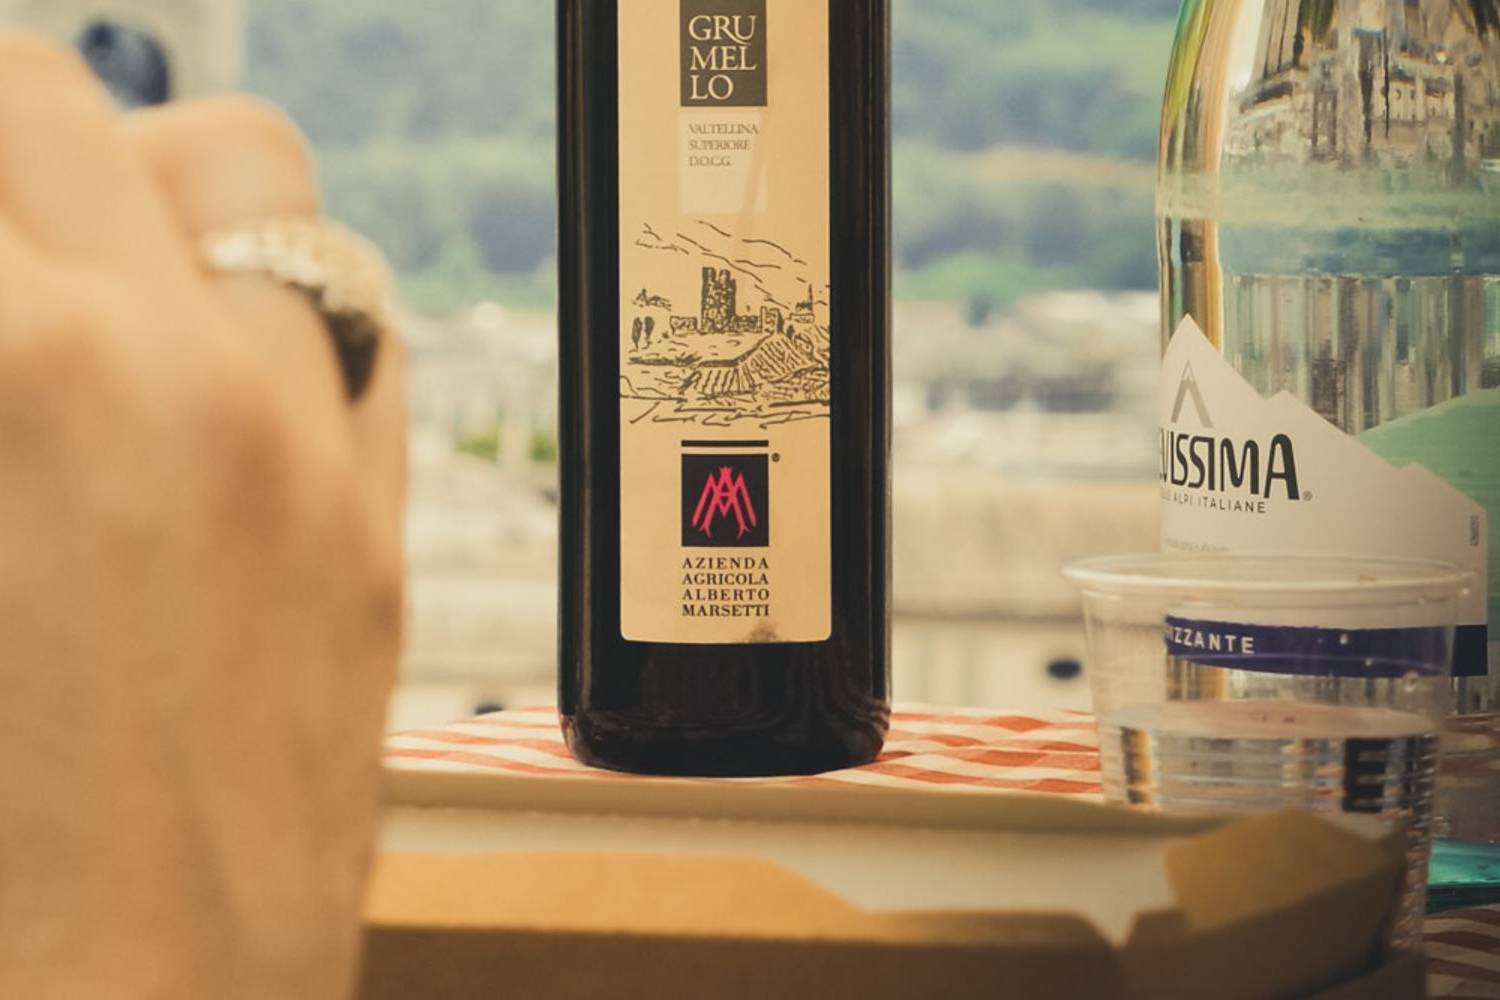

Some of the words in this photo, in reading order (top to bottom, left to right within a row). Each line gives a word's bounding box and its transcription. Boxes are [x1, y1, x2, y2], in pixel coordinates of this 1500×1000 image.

[688, 15, 757, 45] GRU
[689, 46, 757, 71] MEL
[690, 74, 734, 100] LO
[688, 123, 759, 135] VALTELLINA
[688, 139, 750, 151] SUPERIORE
[1196, 495, 1266, 514] ITALIANE
[682, 556, 770, 569] AZIENDA
[682, 572, 769, 585] AGRICOLA
[682, 588, 770, 601] ALBERTO
[682, 604, 770, 617] MARSETTI
